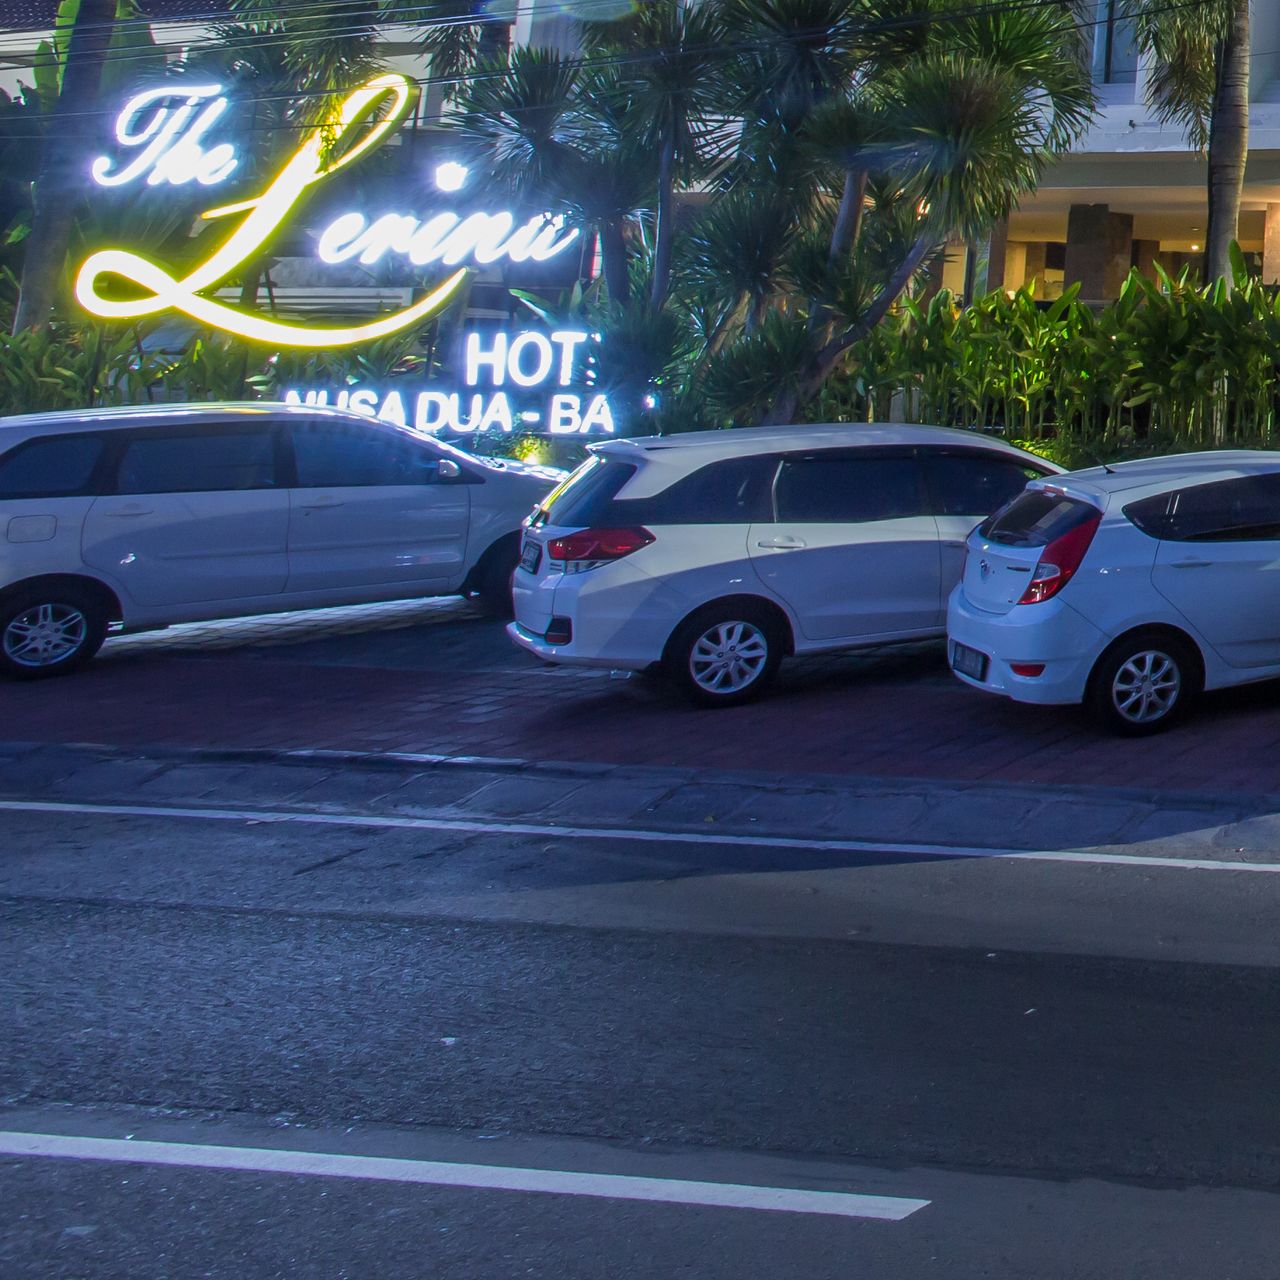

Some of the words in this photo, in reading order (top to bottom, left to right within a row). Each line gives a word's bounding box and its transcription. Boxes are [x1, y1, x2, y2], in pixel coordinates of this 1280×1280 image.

[91, 83, 239, 187] The
[415, 391, 513, 433] DUA
[549, 393, 615, 434] BA
